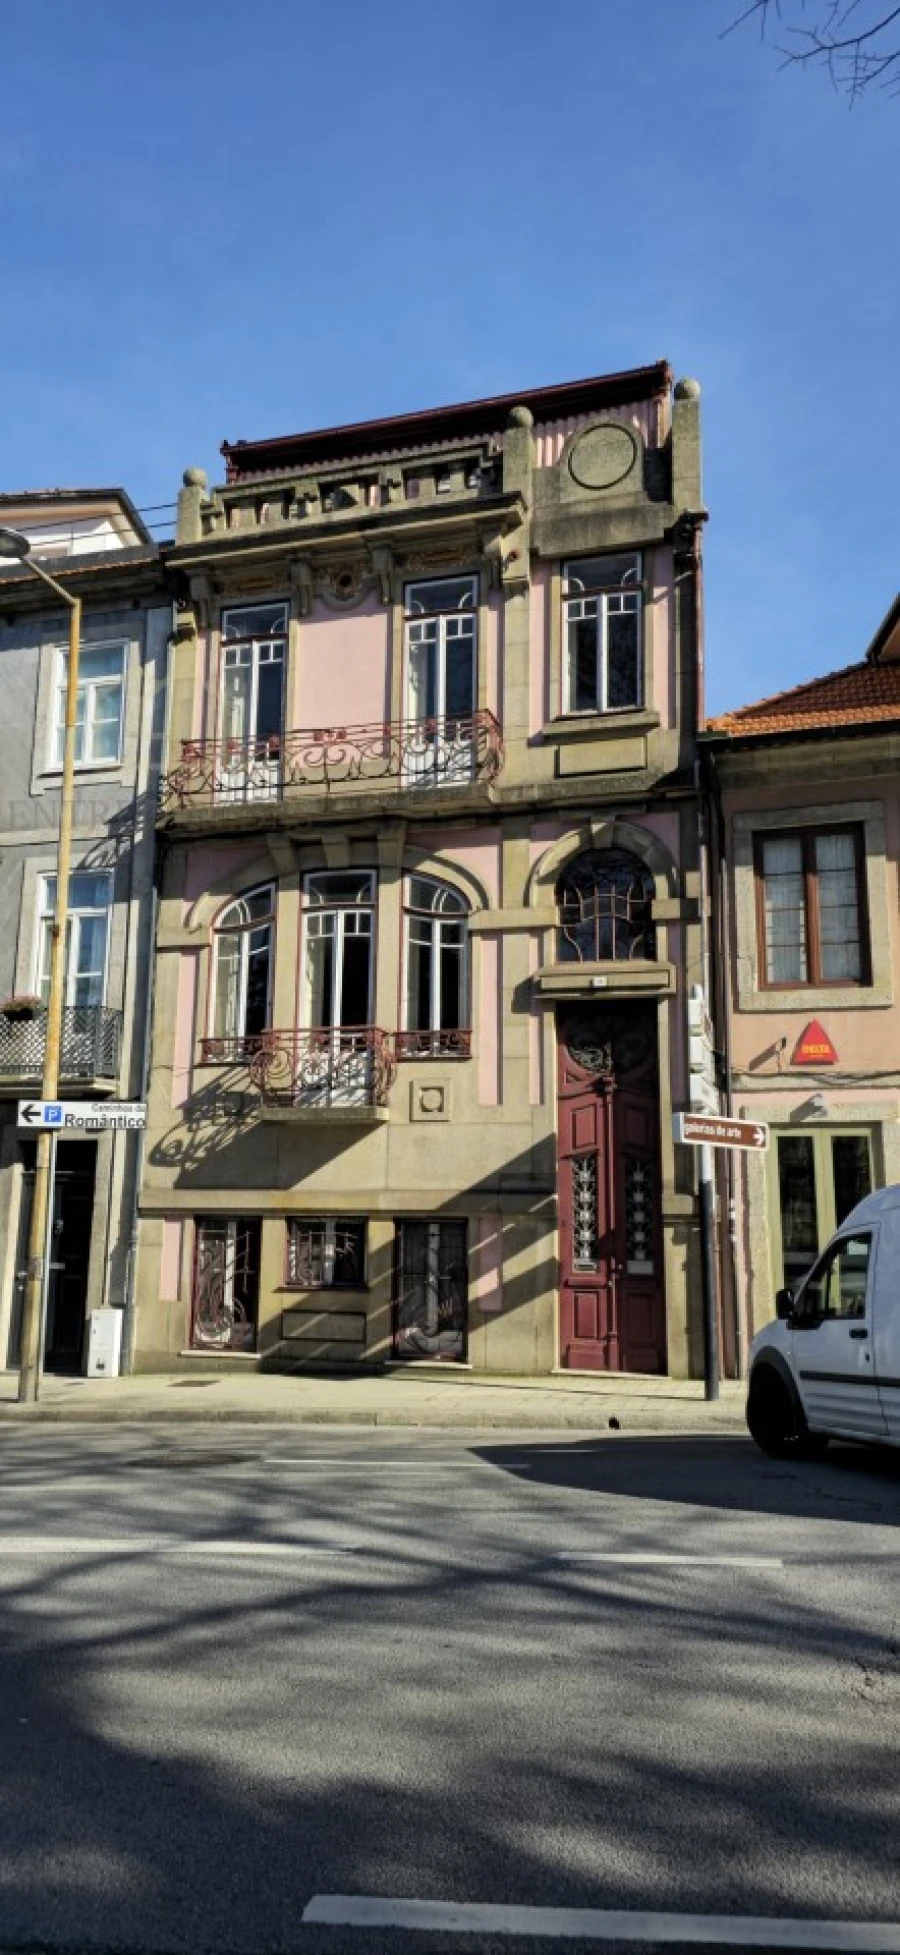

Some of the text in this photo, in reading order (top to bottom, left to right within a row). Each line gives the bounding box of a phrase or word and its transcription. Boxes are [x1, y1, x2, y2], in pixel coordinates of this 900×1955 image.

[65, 1113, 146, 1128] Romântico
[716, 1124, 726, 1136] de
[727, 1126, 742, 1139] arte
